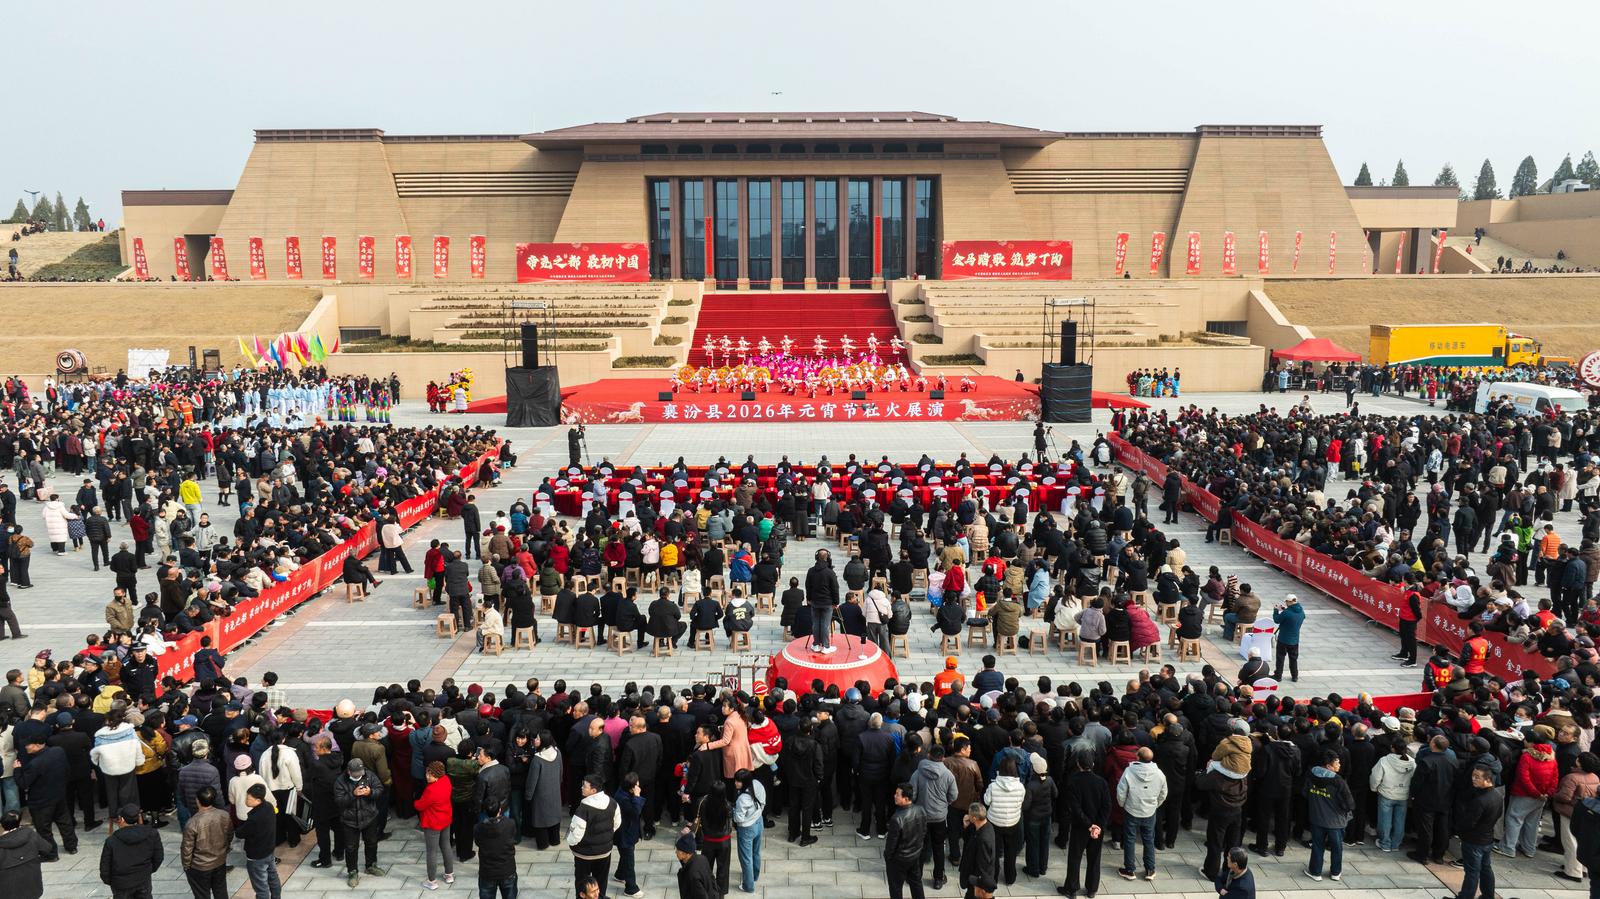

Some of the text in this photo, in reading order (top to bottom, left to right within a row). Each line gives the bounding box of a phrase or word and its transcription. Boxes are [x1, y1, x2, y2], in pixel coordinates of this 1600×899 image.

[526, 254, 639, 270] 帝尧之都 最初中国
[662, 401, 945, 419] 襄汾县2026年元宵节社火展演
[1378, 600, 1400, 617] 筑梦丁
[1434, 616, 1466, 639] 帝尧之都
[1506, 659, 1523, 677] 金马
